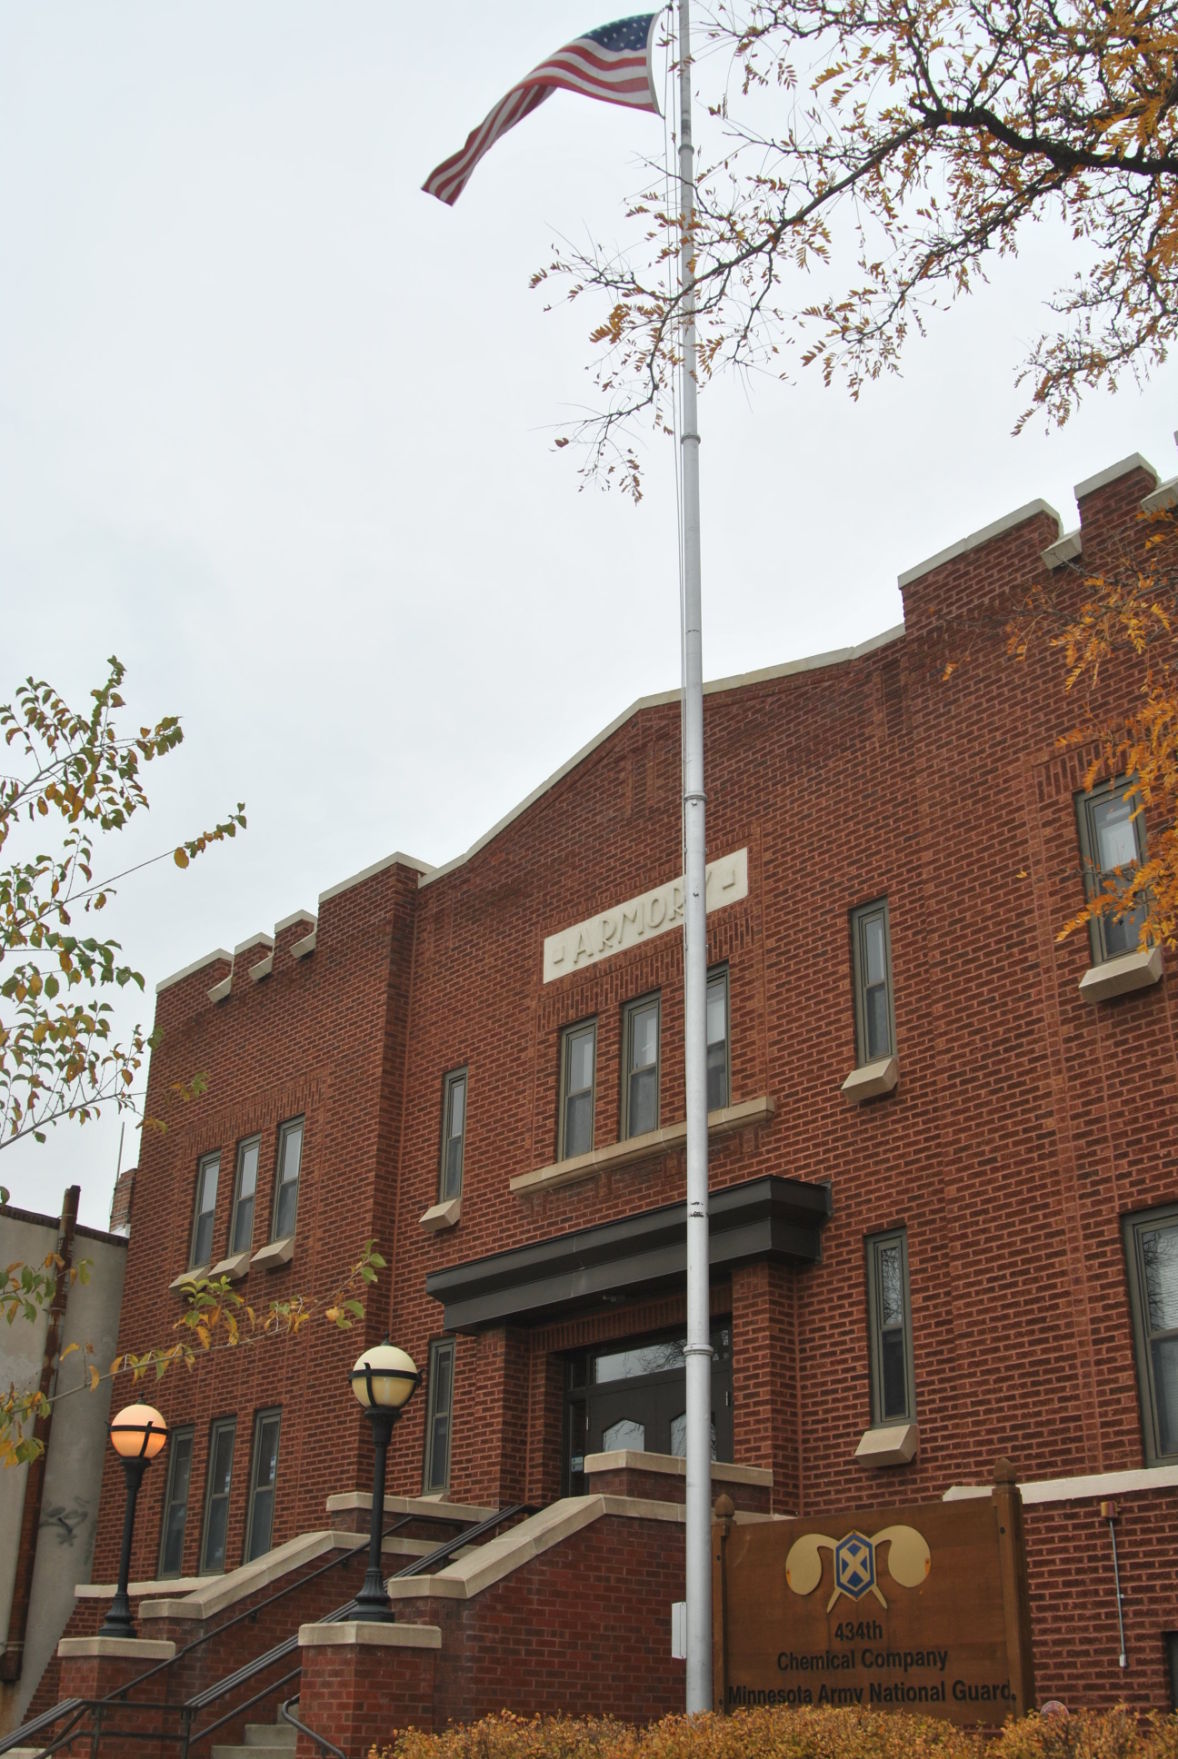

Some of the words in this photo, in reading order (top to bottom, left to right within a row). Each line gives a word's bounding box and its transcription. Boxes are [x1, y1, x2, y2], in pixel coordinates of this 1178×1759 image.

[834, 1619, 883, 1641] 434th
[777, 1649, 856, 1671] Chemical
[861, 1648, 948, 1672] Company
[727, 1685, 812, 1704] Minnesota
[818, 1683, 864, 1705] Army
[869, 1681, 946, 1703] National
